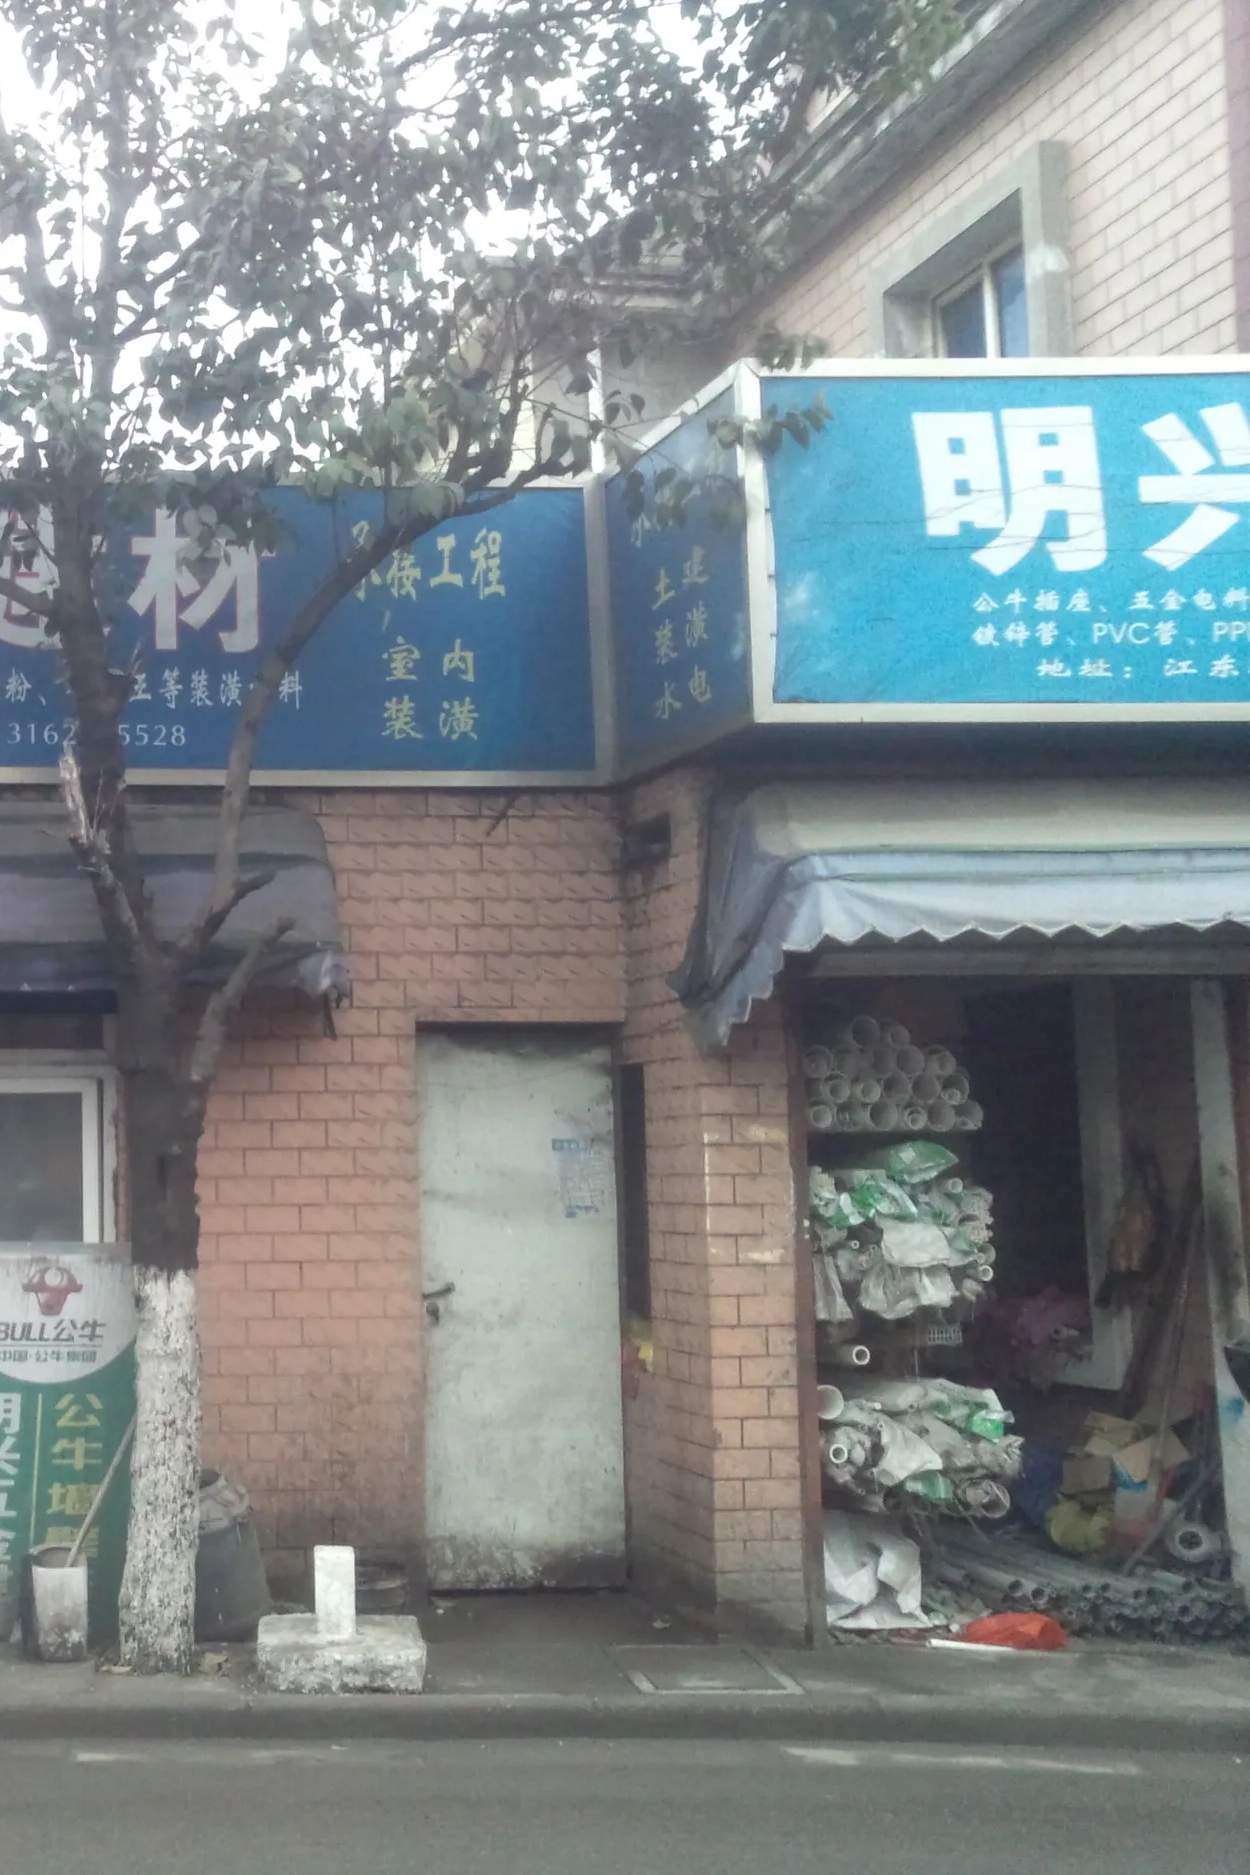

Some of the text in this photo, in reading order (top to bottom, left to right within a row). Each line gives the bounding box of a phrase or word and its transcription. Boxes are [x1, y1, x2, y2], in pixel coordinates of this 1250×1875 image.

[972, 619, 1250, 647] 镀锌管、PVC管、PP
[381, 634, 476, 684] 室内
[1035, 653, 1250, 679] 地址：江东
[380, 693, 481, 742] 装潢
